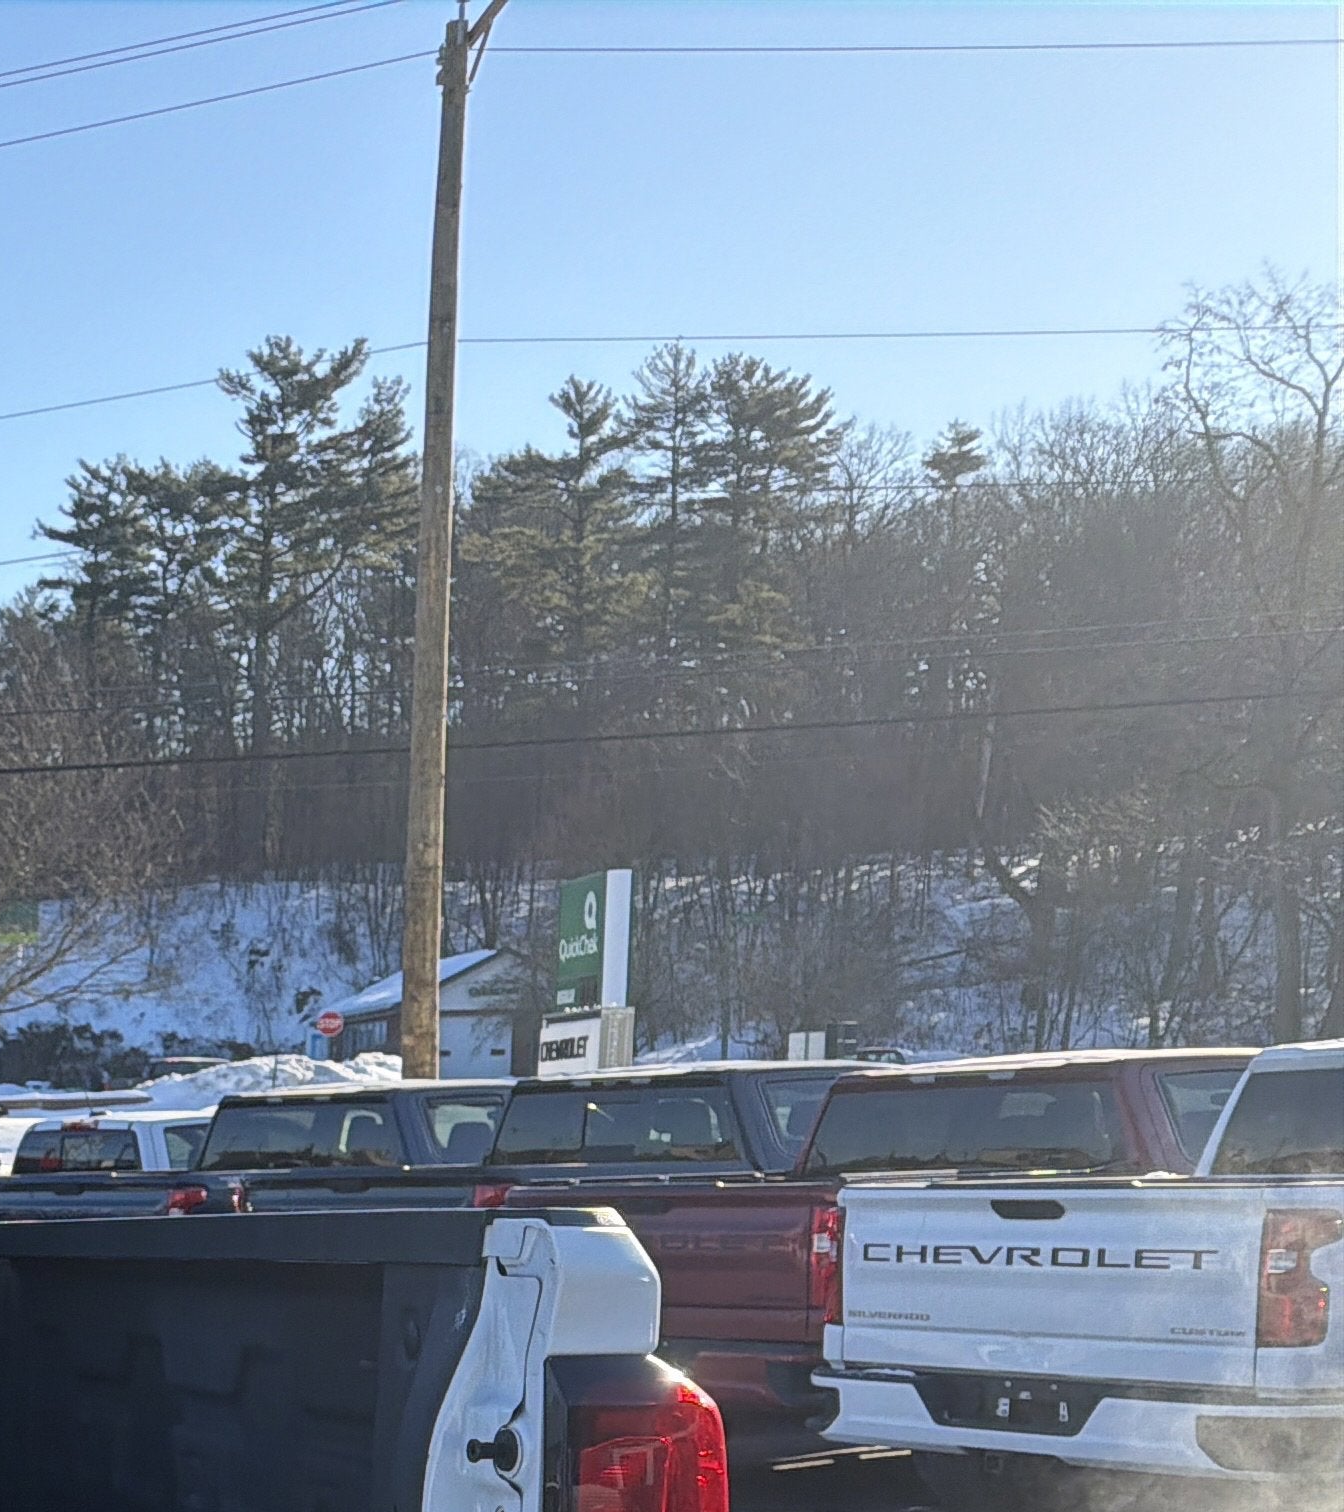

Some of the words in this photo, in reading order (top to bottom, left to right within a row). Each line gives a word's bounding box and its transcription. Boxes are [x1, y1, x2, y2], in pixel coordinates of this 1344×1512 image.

[558, 932, 599, 963] QuickChek
[317, 1017, 343, 1029] STOP
[863, 1243, 1219, 1270] CHEVROLET
